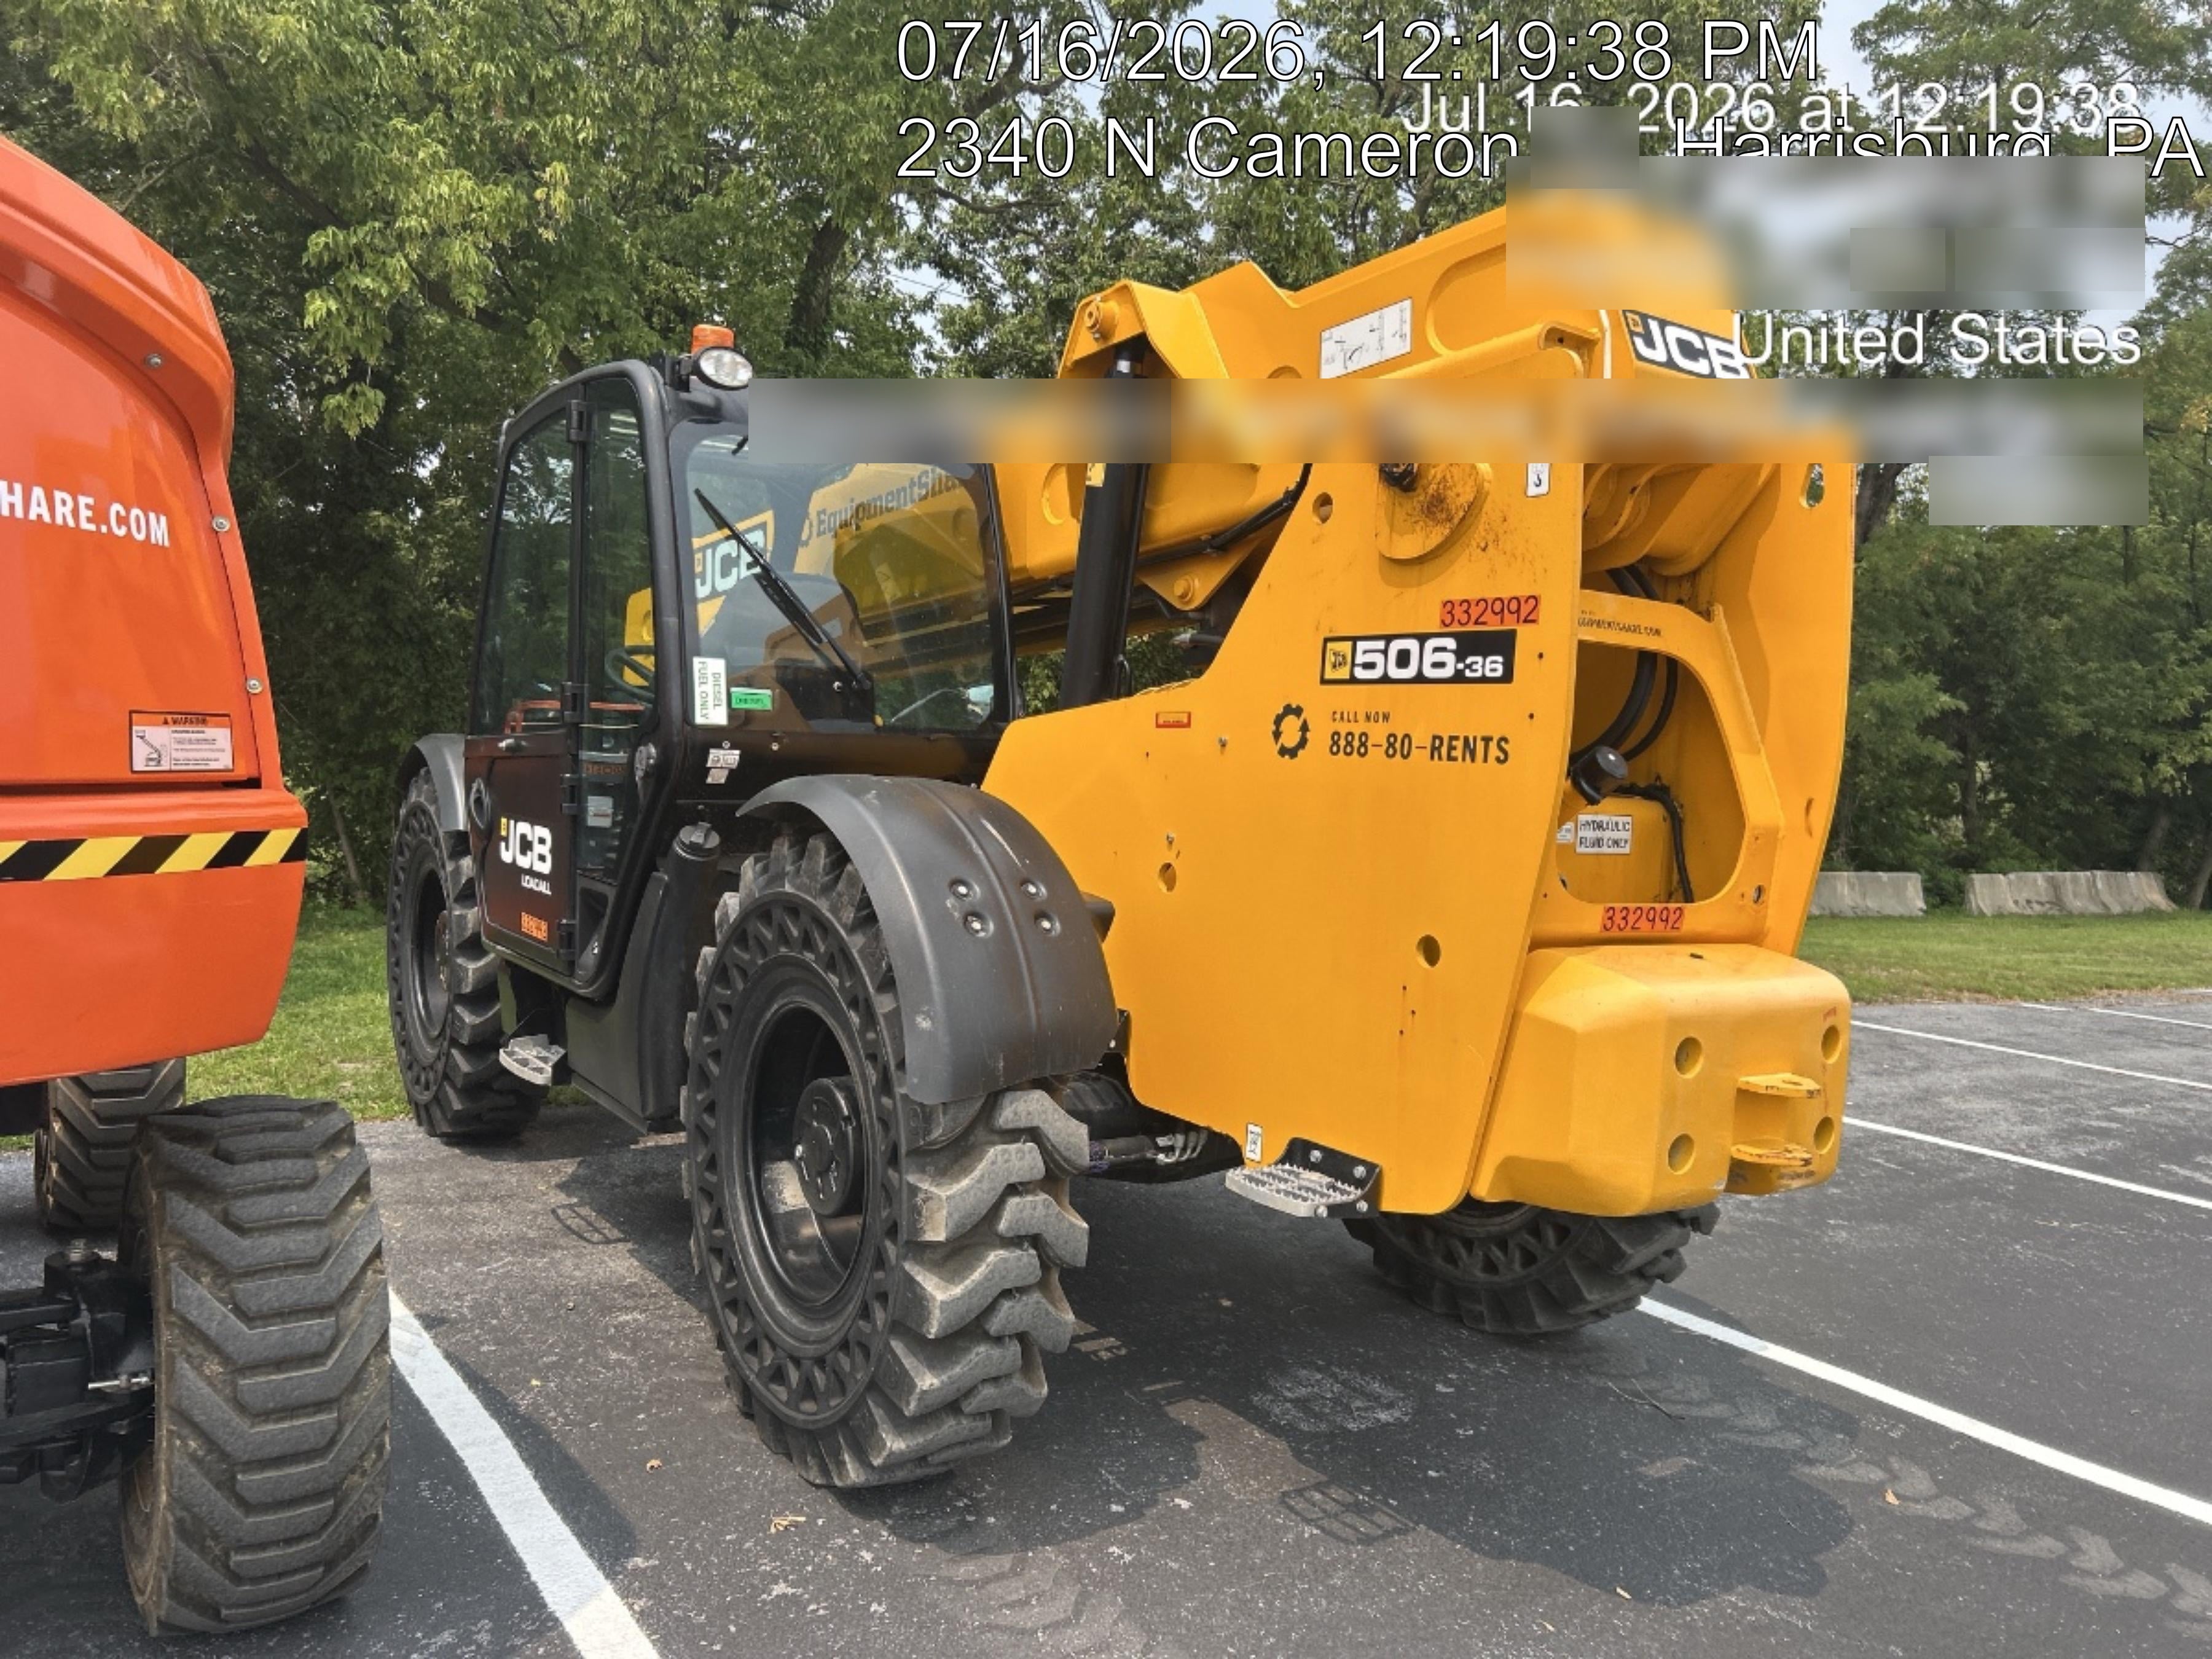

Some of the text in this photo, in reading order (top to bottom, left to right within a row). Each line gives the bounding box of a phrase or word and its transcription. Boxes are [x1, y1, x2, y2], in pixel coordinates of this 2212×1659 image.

[1632, 318, 1751, 378] JCB
[1441, 595, 1539, 627] 332992
[1353, 637, 1504, 680] 506-36
[698, 661, 709, 720] FUEL ONLY
[711, 672, 723, 710] DIESEL
[1332, 710, 1391, 724] CALL NOW
[1328, 731, 1510, 765] 888-80-RENTS
[1579, 819, 1630, 832] HYDRAULIC
[1579, 836, 1604, 849] FLUID
[500, 819, 552, 874] JCB
[1602, 906, 1684, 931] 332992
